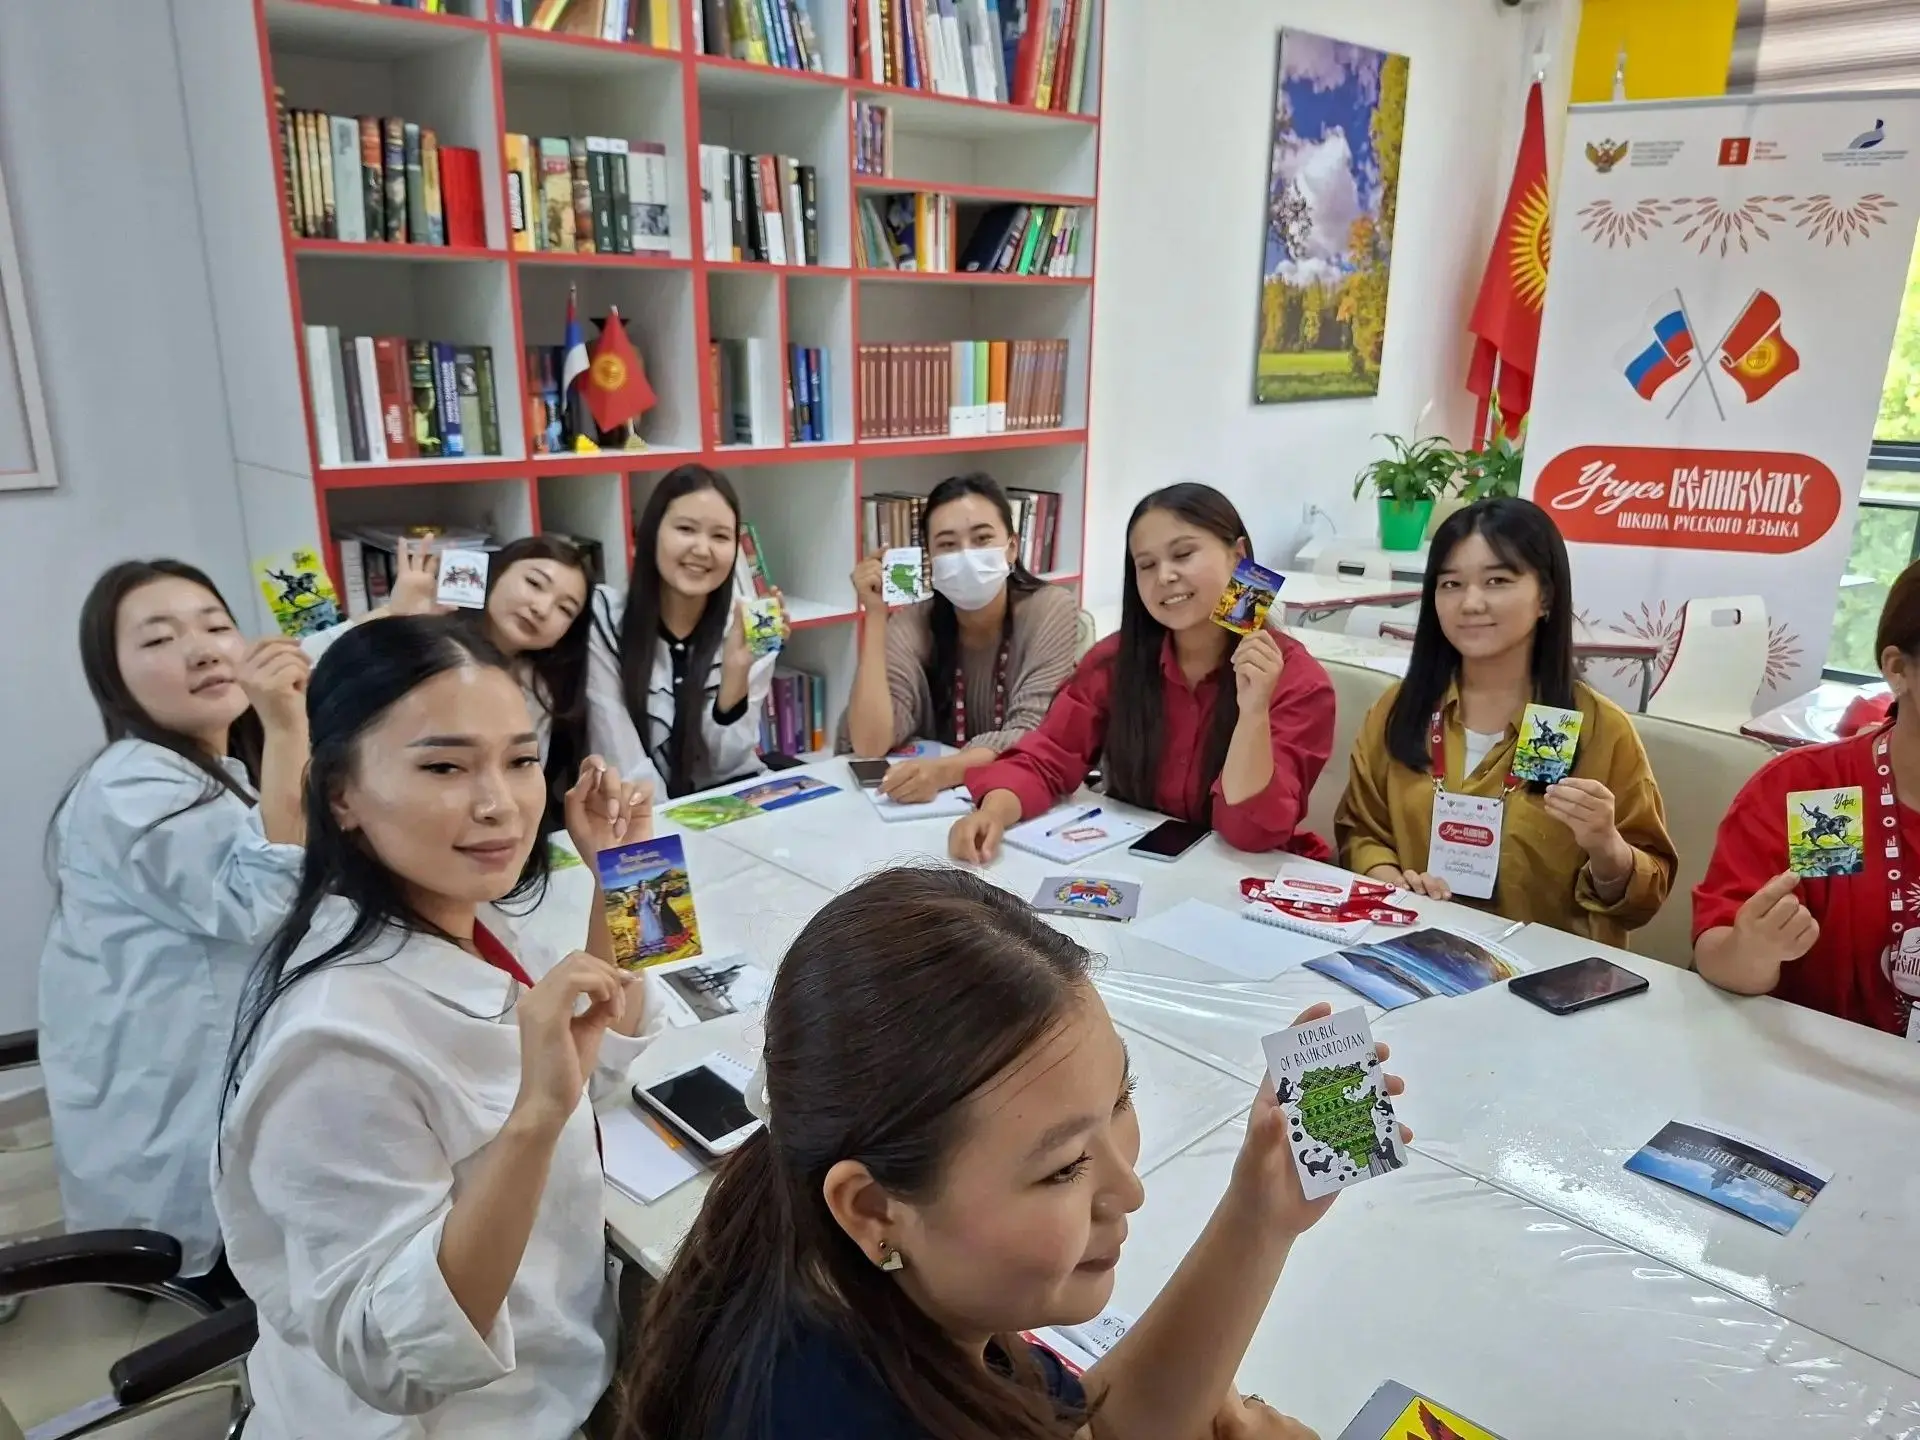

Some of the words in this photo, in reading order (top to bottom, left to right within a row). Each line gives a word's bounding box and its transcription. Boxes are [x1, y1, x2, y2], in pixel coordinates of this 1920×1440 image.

[1551, 460, 1665, 515] Учусь
[1617, 512, 1670, 530] ШКОЛА
[1673, 514, 1742, 534] РУССКОГО
[1745, 517, 1800, 538] ЯЗЫКА
[1833, 792, 1856, 810] Уфа
[1297, 1022, 1338, 1047] REPUBLIC
[1280, 1056, 1291, 1071] OF
[1294, 1031, 1366, 1067] BASHKORTOSTAN
